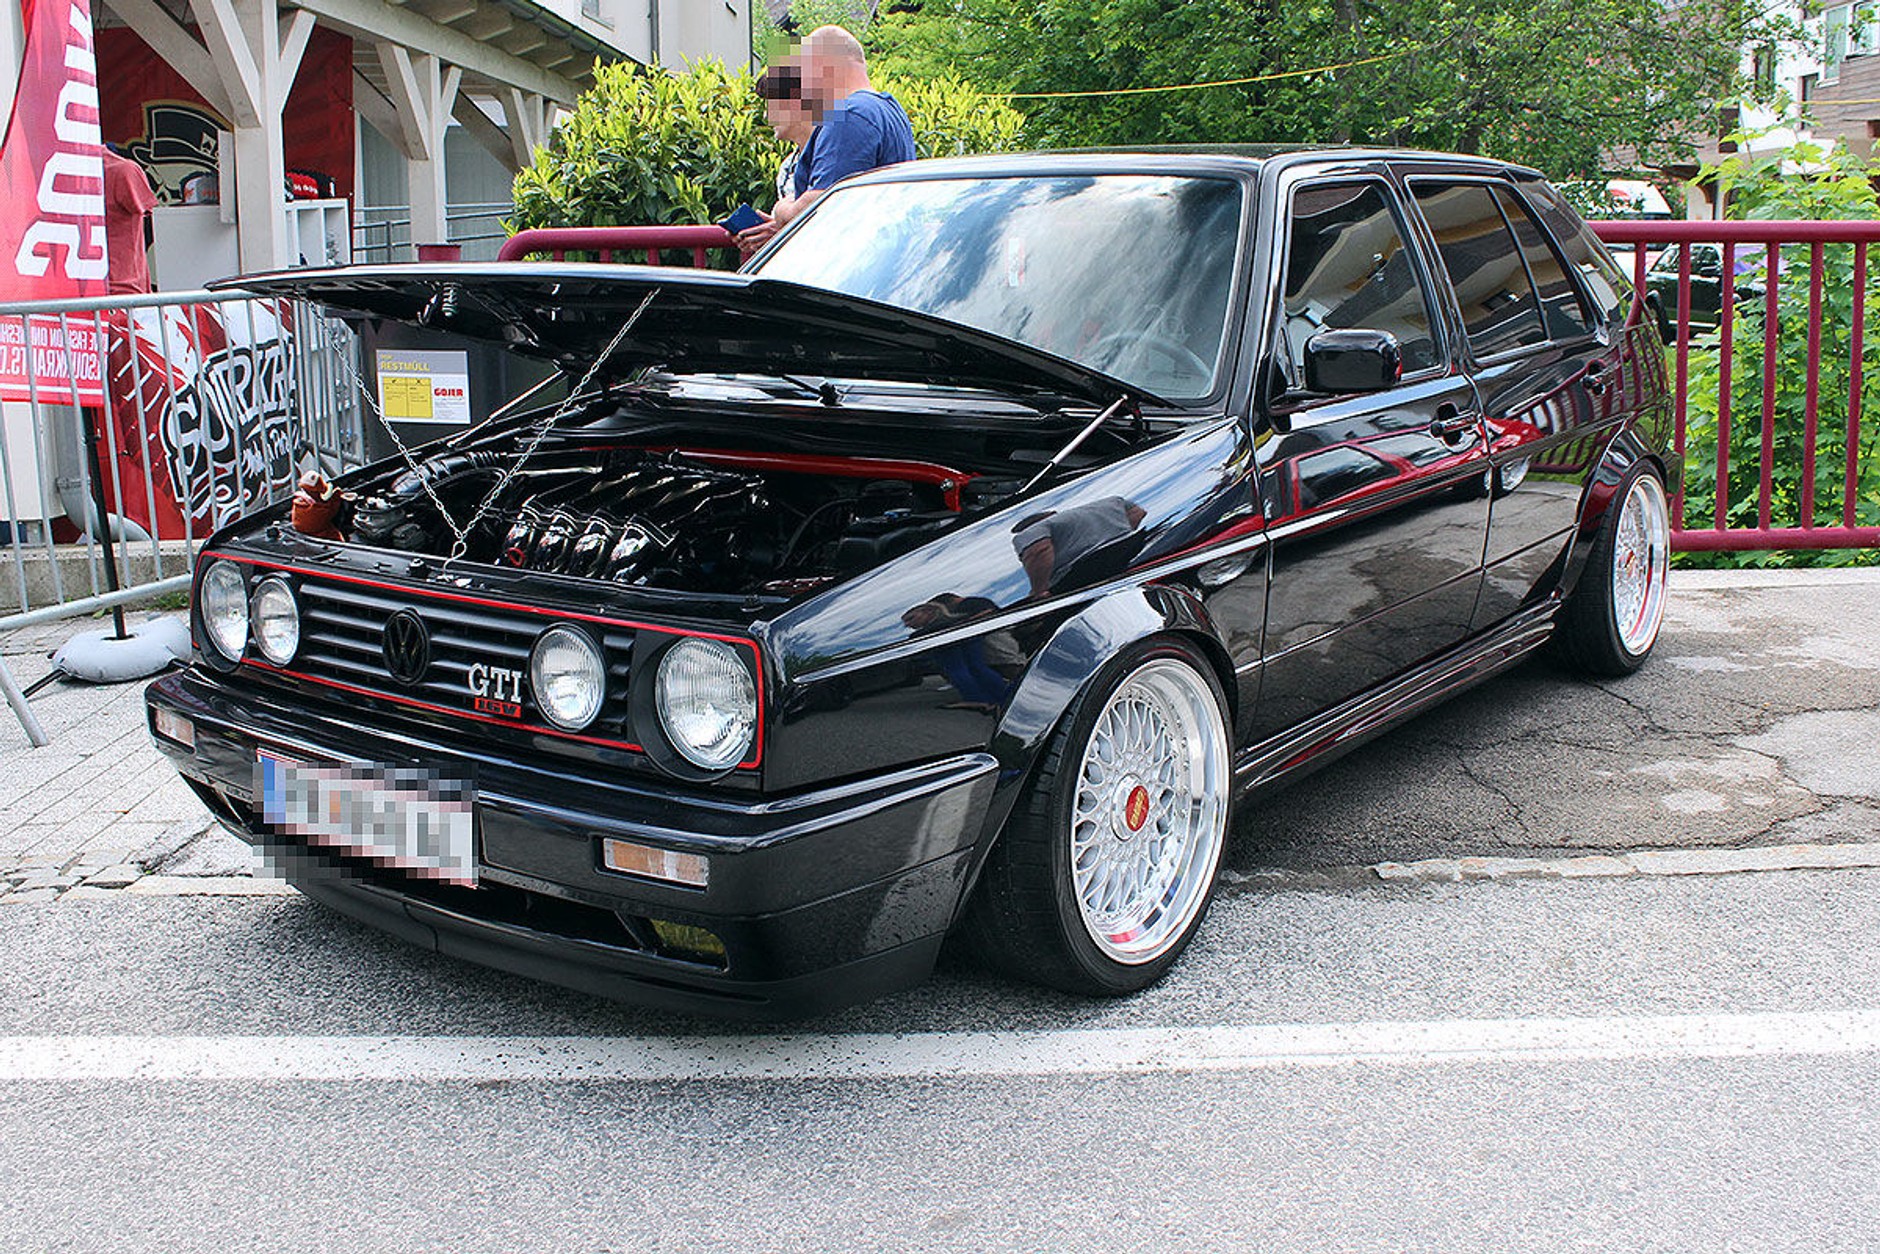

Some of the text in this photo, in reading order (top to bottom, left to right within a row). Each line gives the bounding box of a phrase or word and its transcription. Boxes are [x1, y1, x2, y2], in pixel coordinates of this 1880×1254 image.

[381, 360, 430, 372] RESTMÜLL
[434, 387, 463, 397] GOJER
[468, 662, 522, 703] GTI
